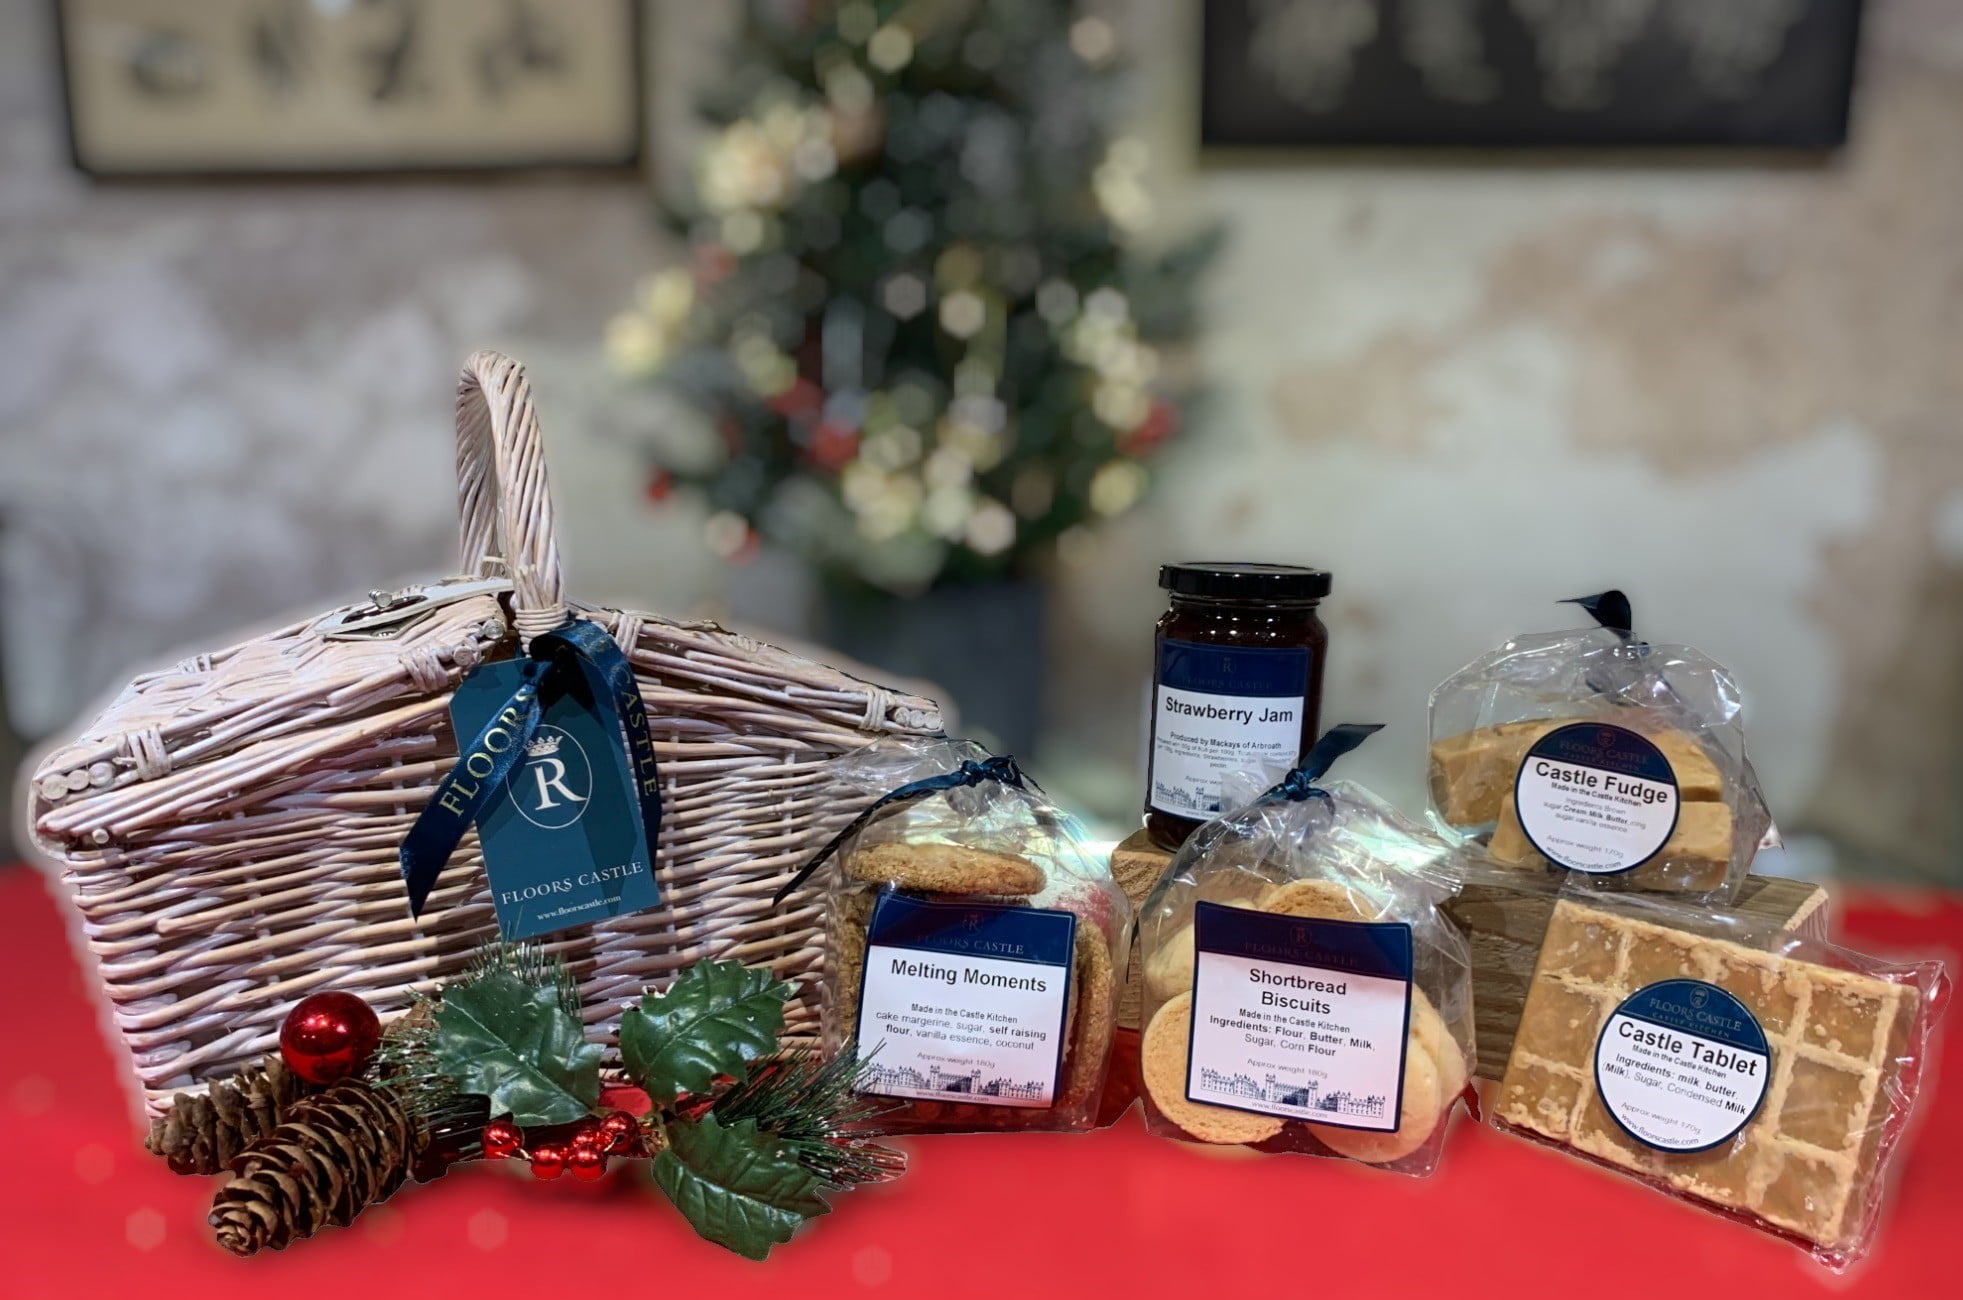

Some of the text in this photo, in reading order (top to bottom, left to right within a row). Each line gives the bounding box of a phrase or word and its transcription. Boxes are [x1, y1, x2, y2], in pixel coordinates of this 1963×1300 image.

[1166, 697, 1292, 725] Strawberry Jam
[613, 662, 658, 796] CASTLE
[1170, 732, 1198, 744] Produced
[1200, 736, 1208, 745] by
[1210, 739, 1240, 749] Mackays
[440, 684, 537, 817] FLOORS
[525, 758, 588, 810] R
[1536, 762, 1667, 804] Castle Fudge
[1551, 782, 1569, 792] Made
[1579, 788, 1590, 797] the
[1592, 791, 1613, 801] Castle
[1615, 796, 1641, 807] Kitchen
[1563, 805, 1586, 814] Cream
[1589, 810, 1603, 818] Milk
[501, 861, 644, 904] FLOORS CASTLE
[537, 894, 622, 921] www.floorscastle.com
[974, 939, 1024, 954] CASTLE
[891, 959, 1047, 992] Melting Moments
[1250, 969, 1346, 995] Shortbread
[911, 1003, 1018, 1023] Made in the Castle Kitchen
[1261, 992, 1330, 1014] Biscuits
[1649, 998, 1742, 1031] FLOORS CASTLE
[876, 1011, 899, 1022] cake
[989, 1025, 1008, 1036] self
[1011, 1029, 1047, 1041] raising
[1210, 1015, 1272, 1034] Ingredients:
[1239, 1008, 1350, 1033] Made in the Castle Kitchen
[916, 1029, 947, 1040] vanilla
[996, 1039, 1034, 1050] coconut
[1280, 1040, 1304, 1052] Corn
[1308, 1044, 1336, 1057] Flour
[1619, 1022, 1757, 1076] Castle Tablet
[1247, 1058, 1276, 1070] Approx
[1278, 1063, 1305, 1075] weight
[1616, 1053, 1675, 1078] Ingredients:
[1632, 1045, 1651, 1056] Made
[1661, 1054, 1672, 1062] the
[1674, 1057, 1696, 1070] Castle
[1698, 1065, 1726, 1079] Kitchen
[1252, 1101, 1328, 1119] www.floorscastle.com
[1667, 1082, 1722, 1108] Condensed
[1725, 1100, 1746, 1115] Milk
[1621, 1101, 1649, 1116] Approx
[1652, 1112, 1678, 1125] weight
[1622, 1114, 1699, 1145] www.floorscastle.com
